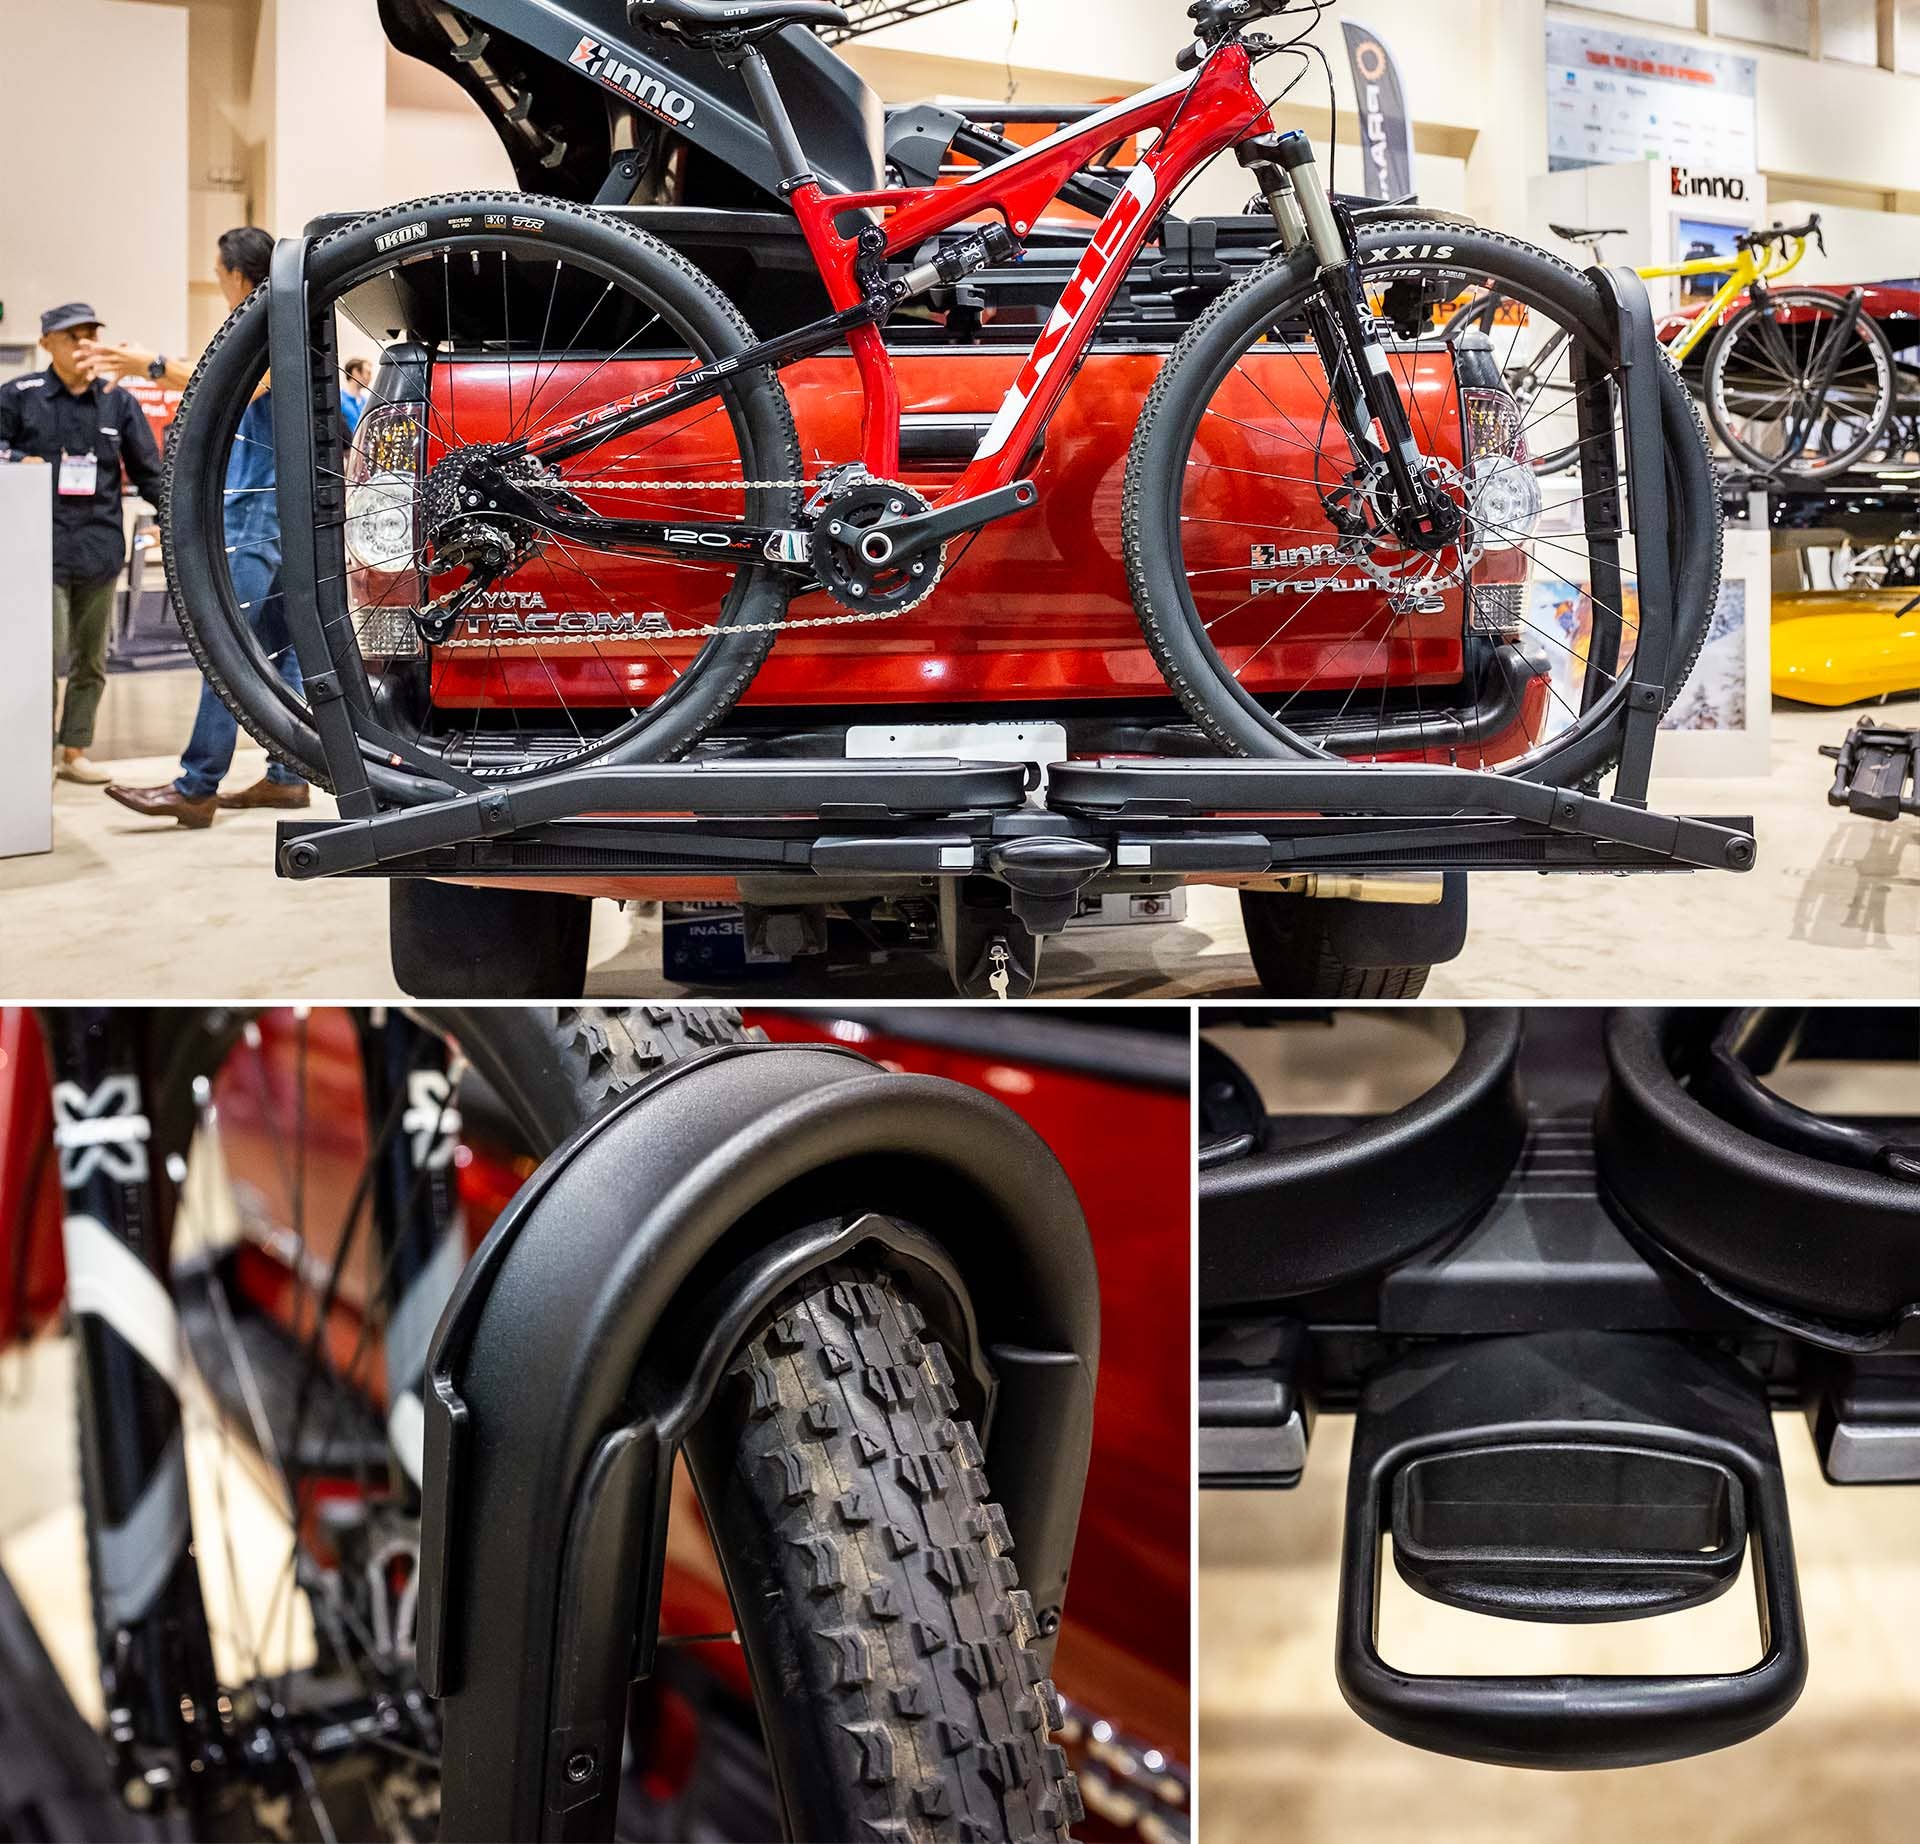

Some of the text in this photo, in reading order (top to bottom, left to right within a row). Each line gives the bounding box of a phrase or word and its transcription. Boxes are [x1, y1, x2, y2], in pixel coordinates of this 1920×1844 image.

[724, 7, 749, 16] WTB
[600, 76, 637, 101] ADVANCED
[638, 99, 653, 111] CAR
[484, 215, 506, 224] EXO
[512, 216, 545, 229] TR
[375, 222, 428, 252] IKON
[1358, 244, 1455, 265] XXIS
[1016, 186, 1141, 398] KHS
[1407, 464, 1427, 506] SLIDE
[464, 591, 547, 609] OYOTA
[1388, 596, 1446, 614] V6
[456, 612, 672, 633] TACOMA
